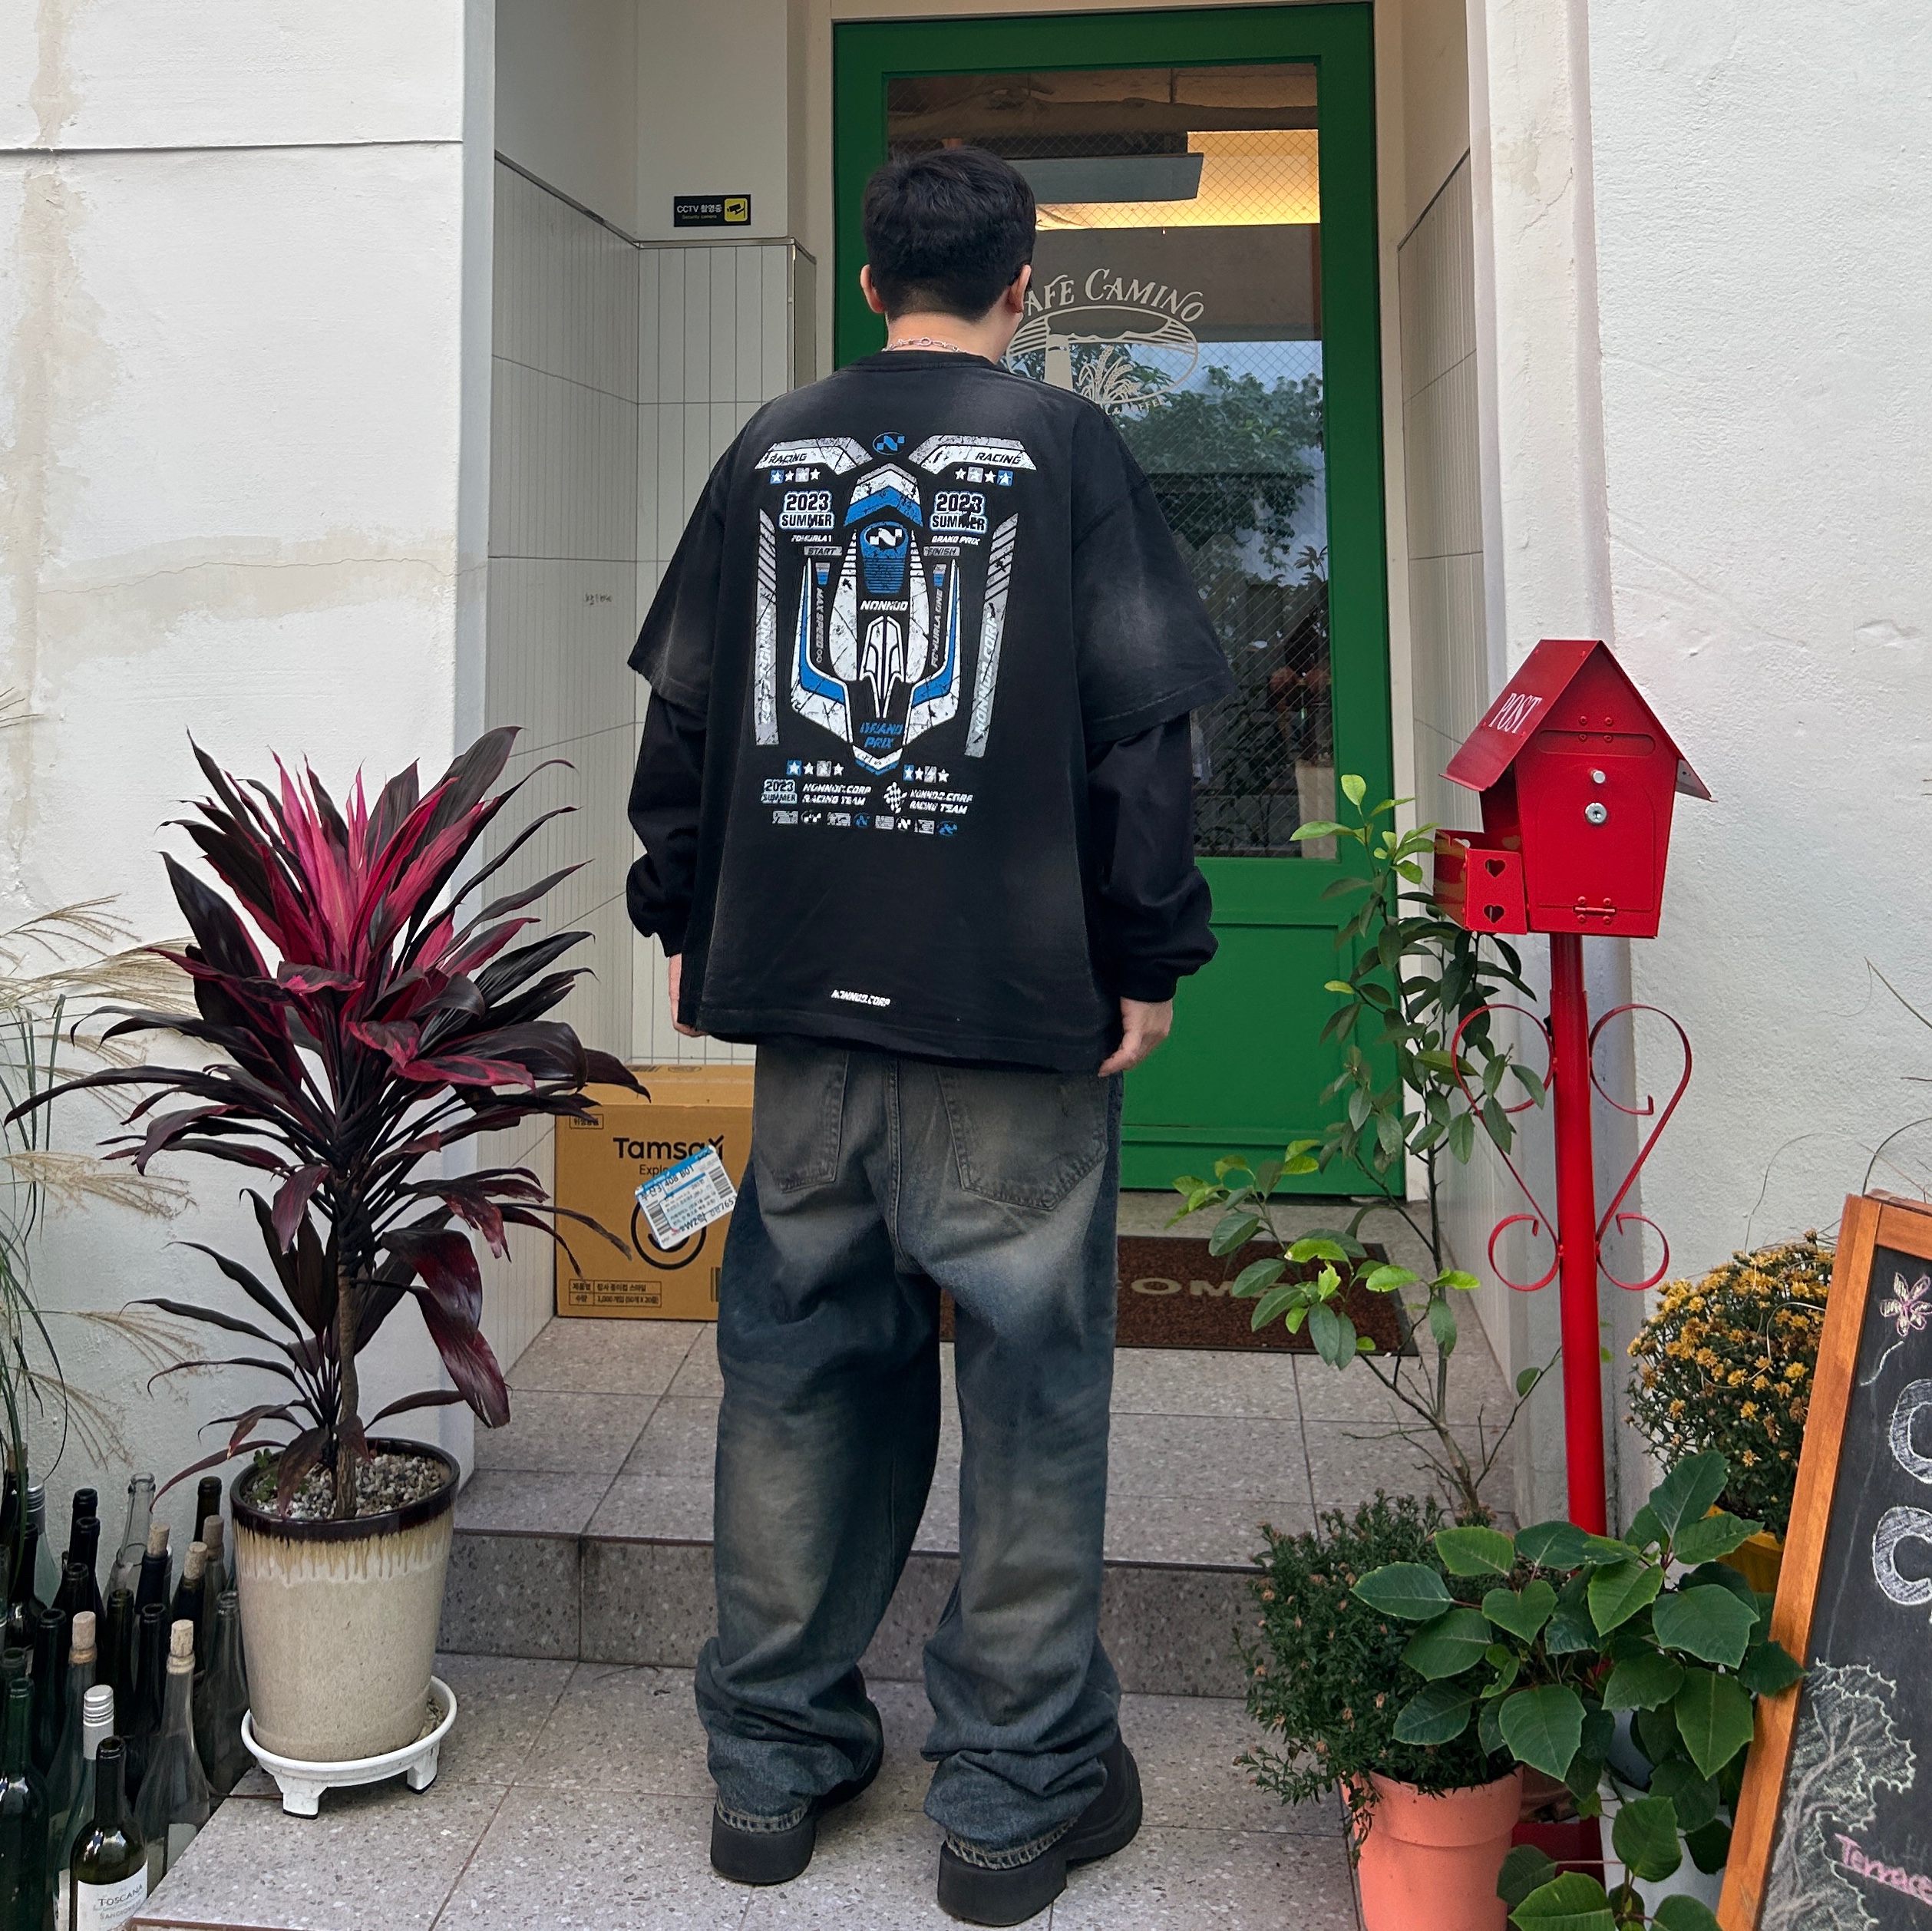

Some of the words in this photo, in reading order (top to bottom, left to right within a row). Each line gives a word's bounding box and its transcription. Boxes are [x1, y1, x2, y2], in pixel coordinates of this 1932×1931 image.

[677, 205, 699, 213] CCTV
[1024, 274, 1075, 316] AFE
[974, 452, 1022, 464] RACING
[785, 493, 830, 511] 2023
[936, 493, 983, 514] 2023
[781, 513, 833, 527] SUMMER
[959, 536, 981, 546] PRIX
[935, 588, 943, 613] ONE
[1488, 692, 1543, 734] POST
[864, 735, 895, 748] PRIX
[764, 778, 796, 792] 2023
[801, 794, 840, 804] RACING
[841, 795, 867, 805] TEAM
[909, 800, 939, 812] RACING
[940, 803, 968, 814] TEAM
[664, 1174, 679, 1187] 408
[679, 1164, 695, 1179] B01
[97, 1883, 143, 1906] TOSCANA
